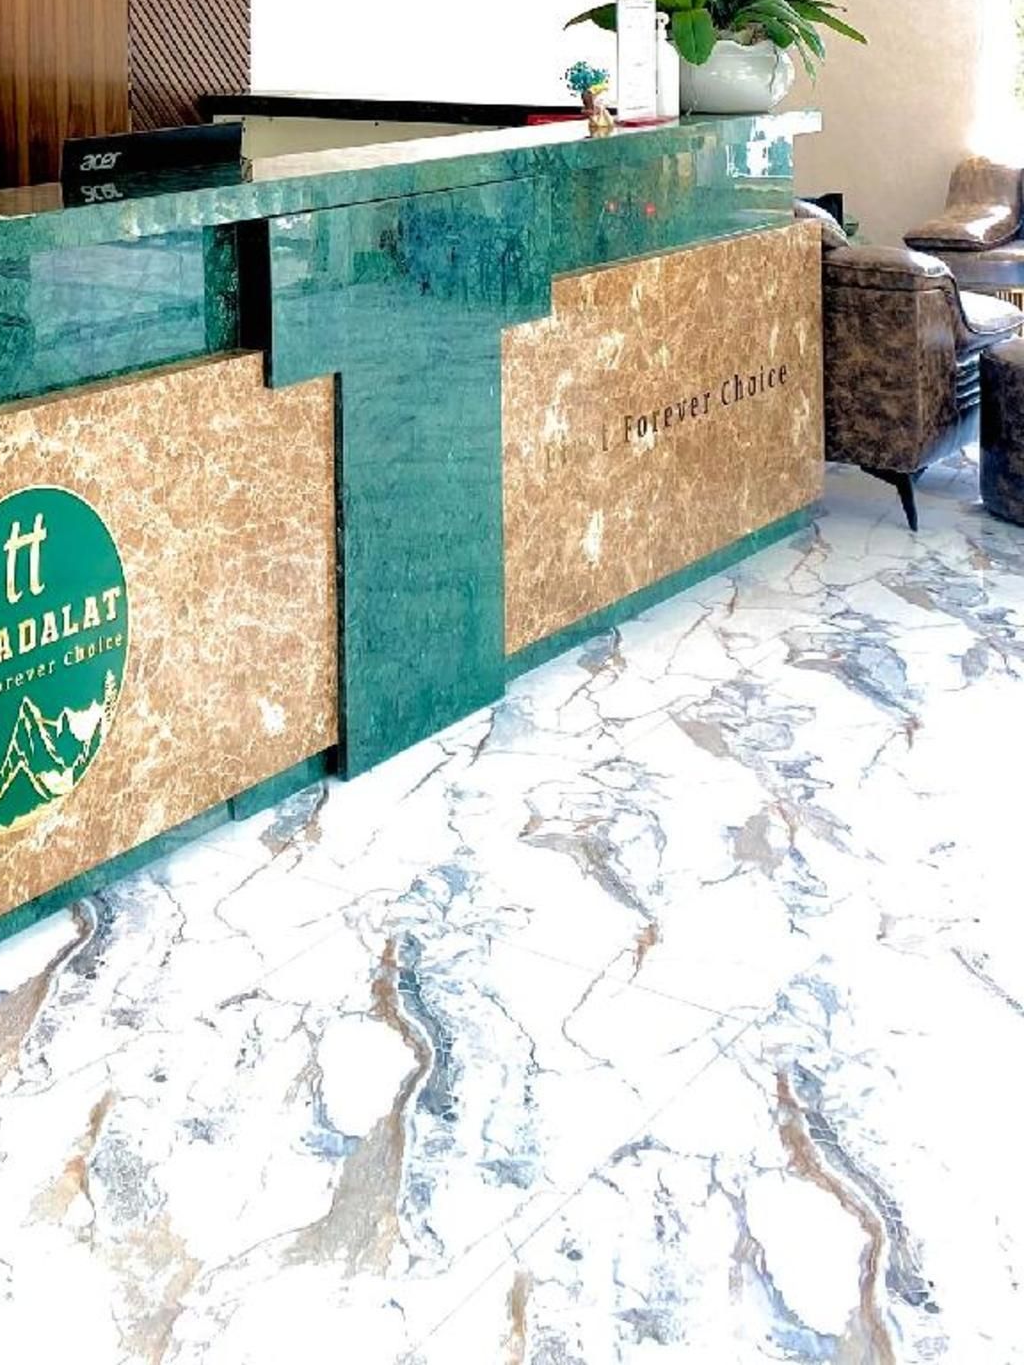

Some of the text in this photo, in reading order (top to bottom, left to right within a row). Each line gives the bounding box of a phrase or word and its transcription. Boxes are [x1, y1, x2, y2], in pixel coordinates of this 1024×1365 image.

[80, 152, 122, 171] acer
[624, 390, 711, 443] Forever
[720, 363, 788, 406] Choice
[63, 633, 124, 667] Choice
